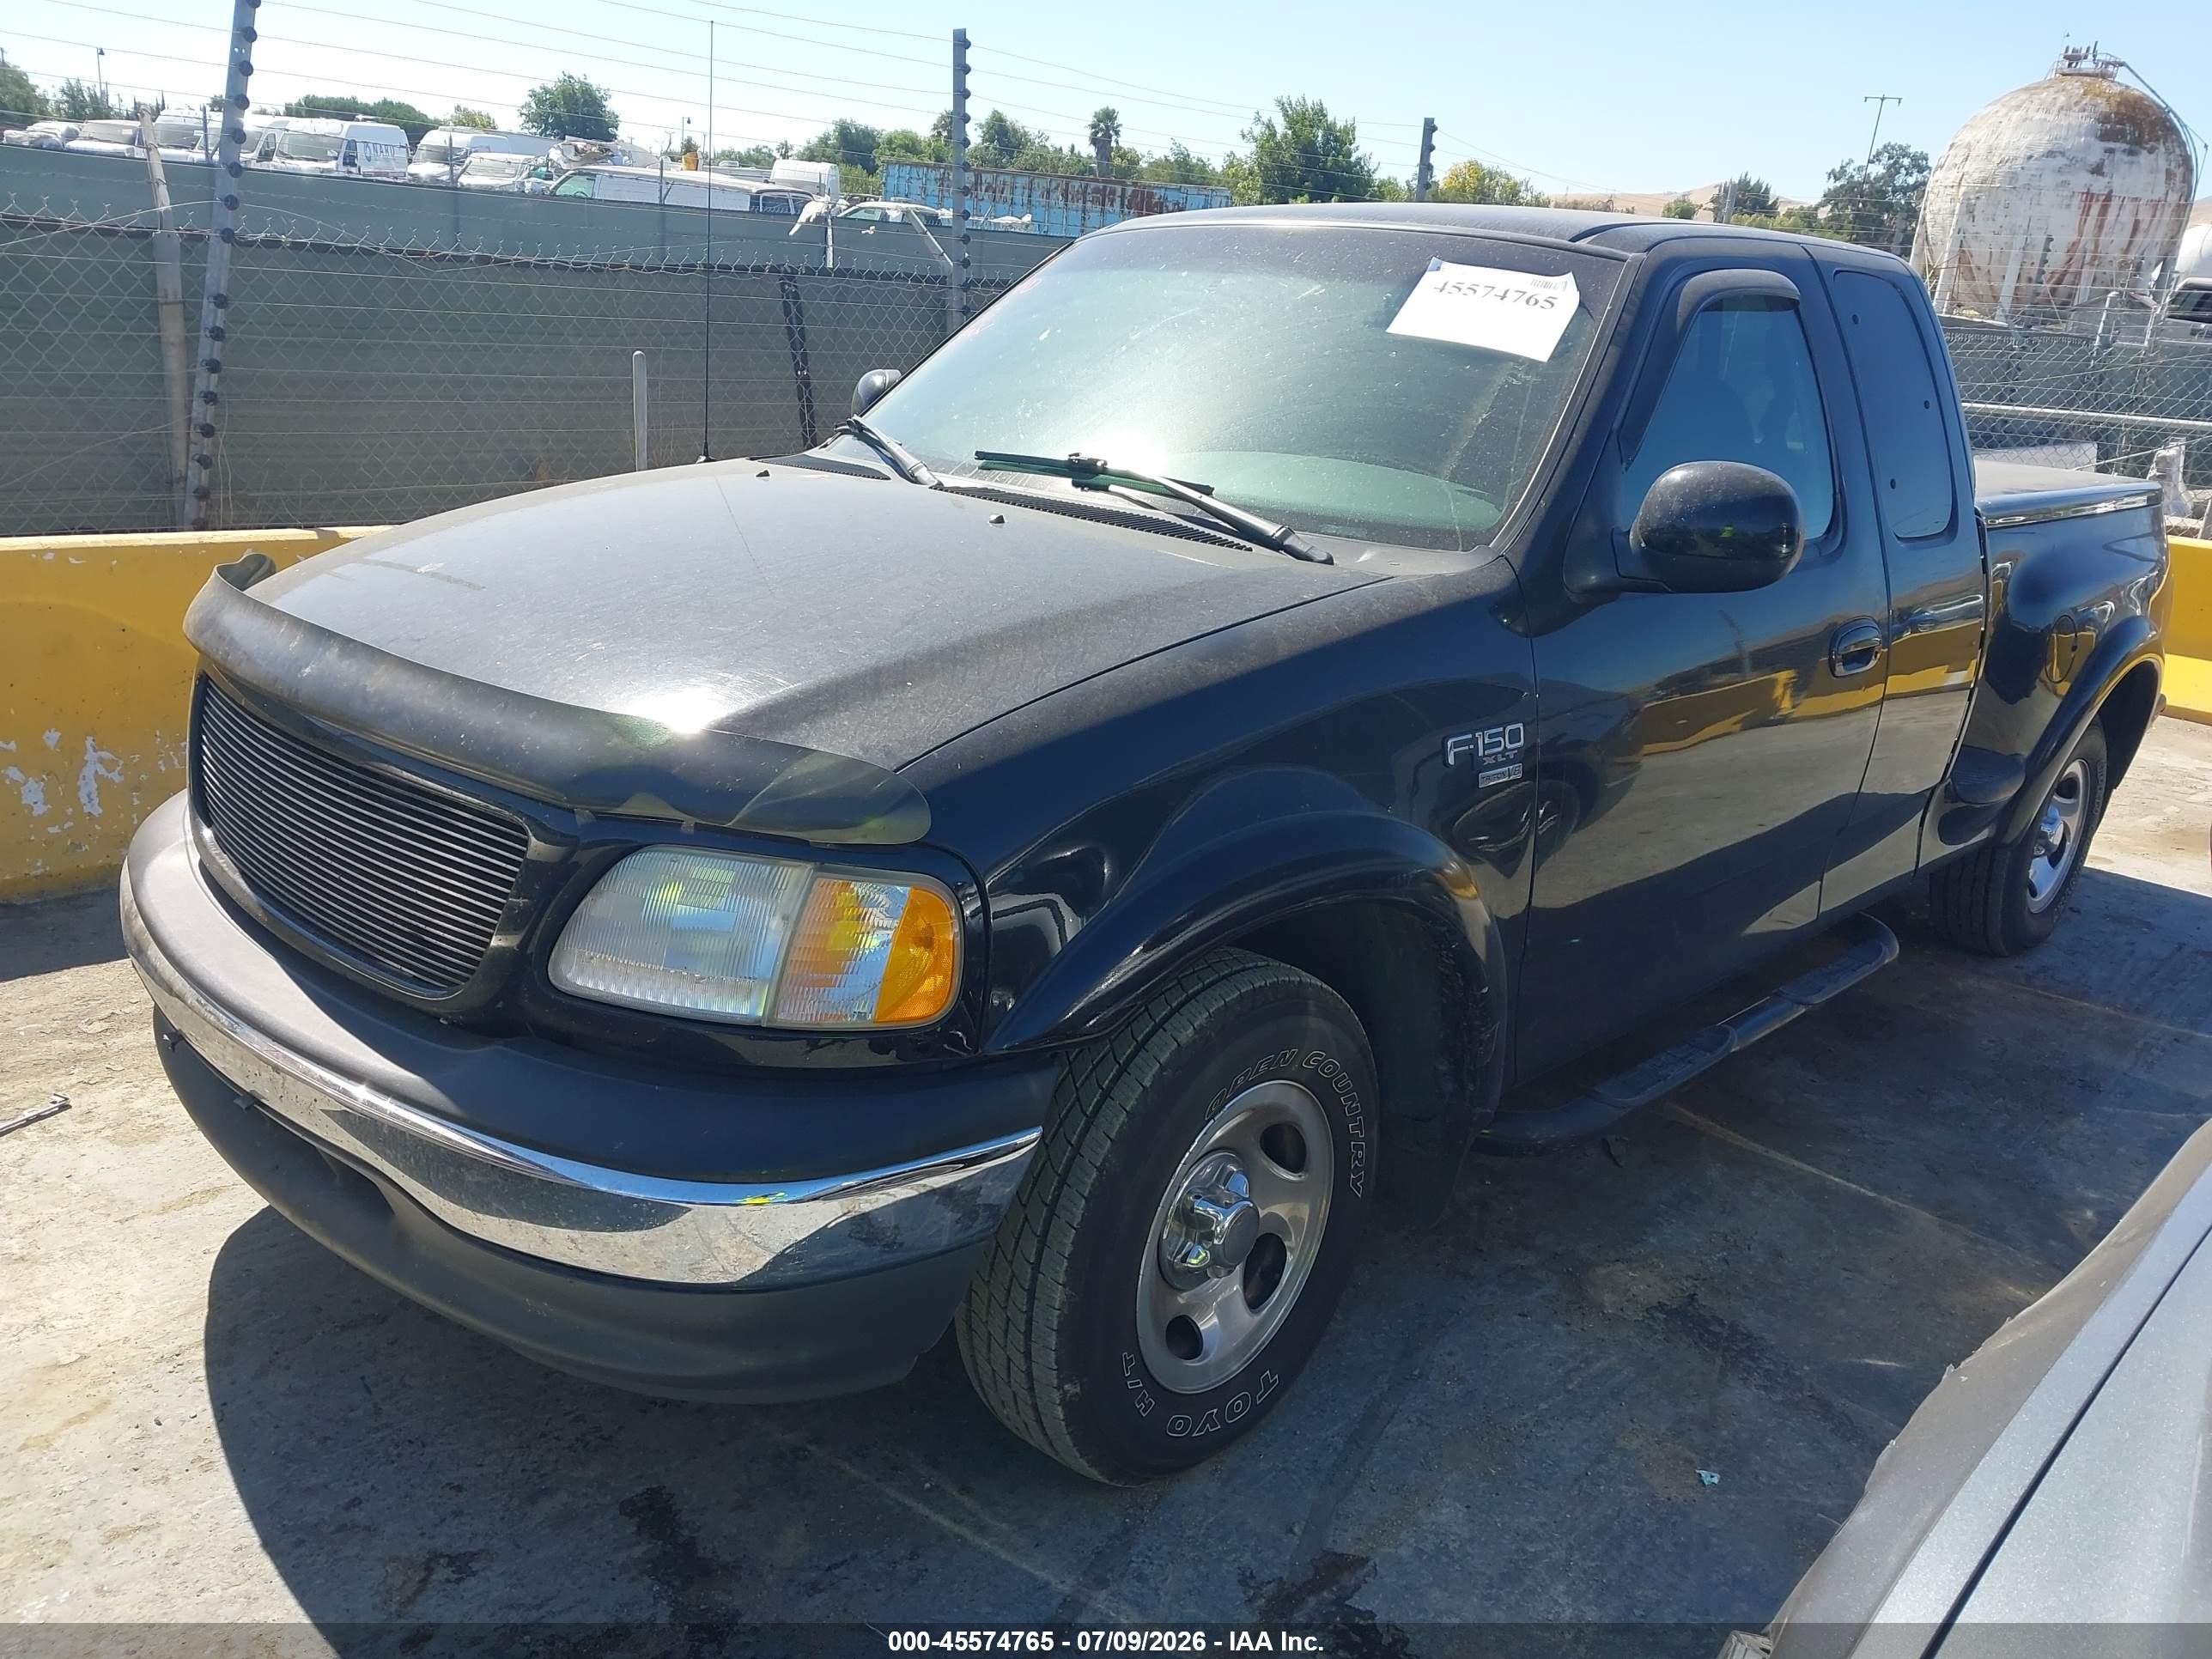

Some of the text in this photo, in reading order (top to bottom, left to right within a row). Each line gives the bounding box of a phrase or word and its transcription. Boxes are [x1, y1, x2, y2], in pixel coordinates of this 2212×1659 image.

[1434, 281, 1559, 310] 45574765
[1447, 722, 1524, 765] F-150
[1482, 750, 1518, 765] XLT
[1205, 1048, 1365, 1198] OPEN COUNTRY
[1166, 1370, 1279, 1437] TOYO
